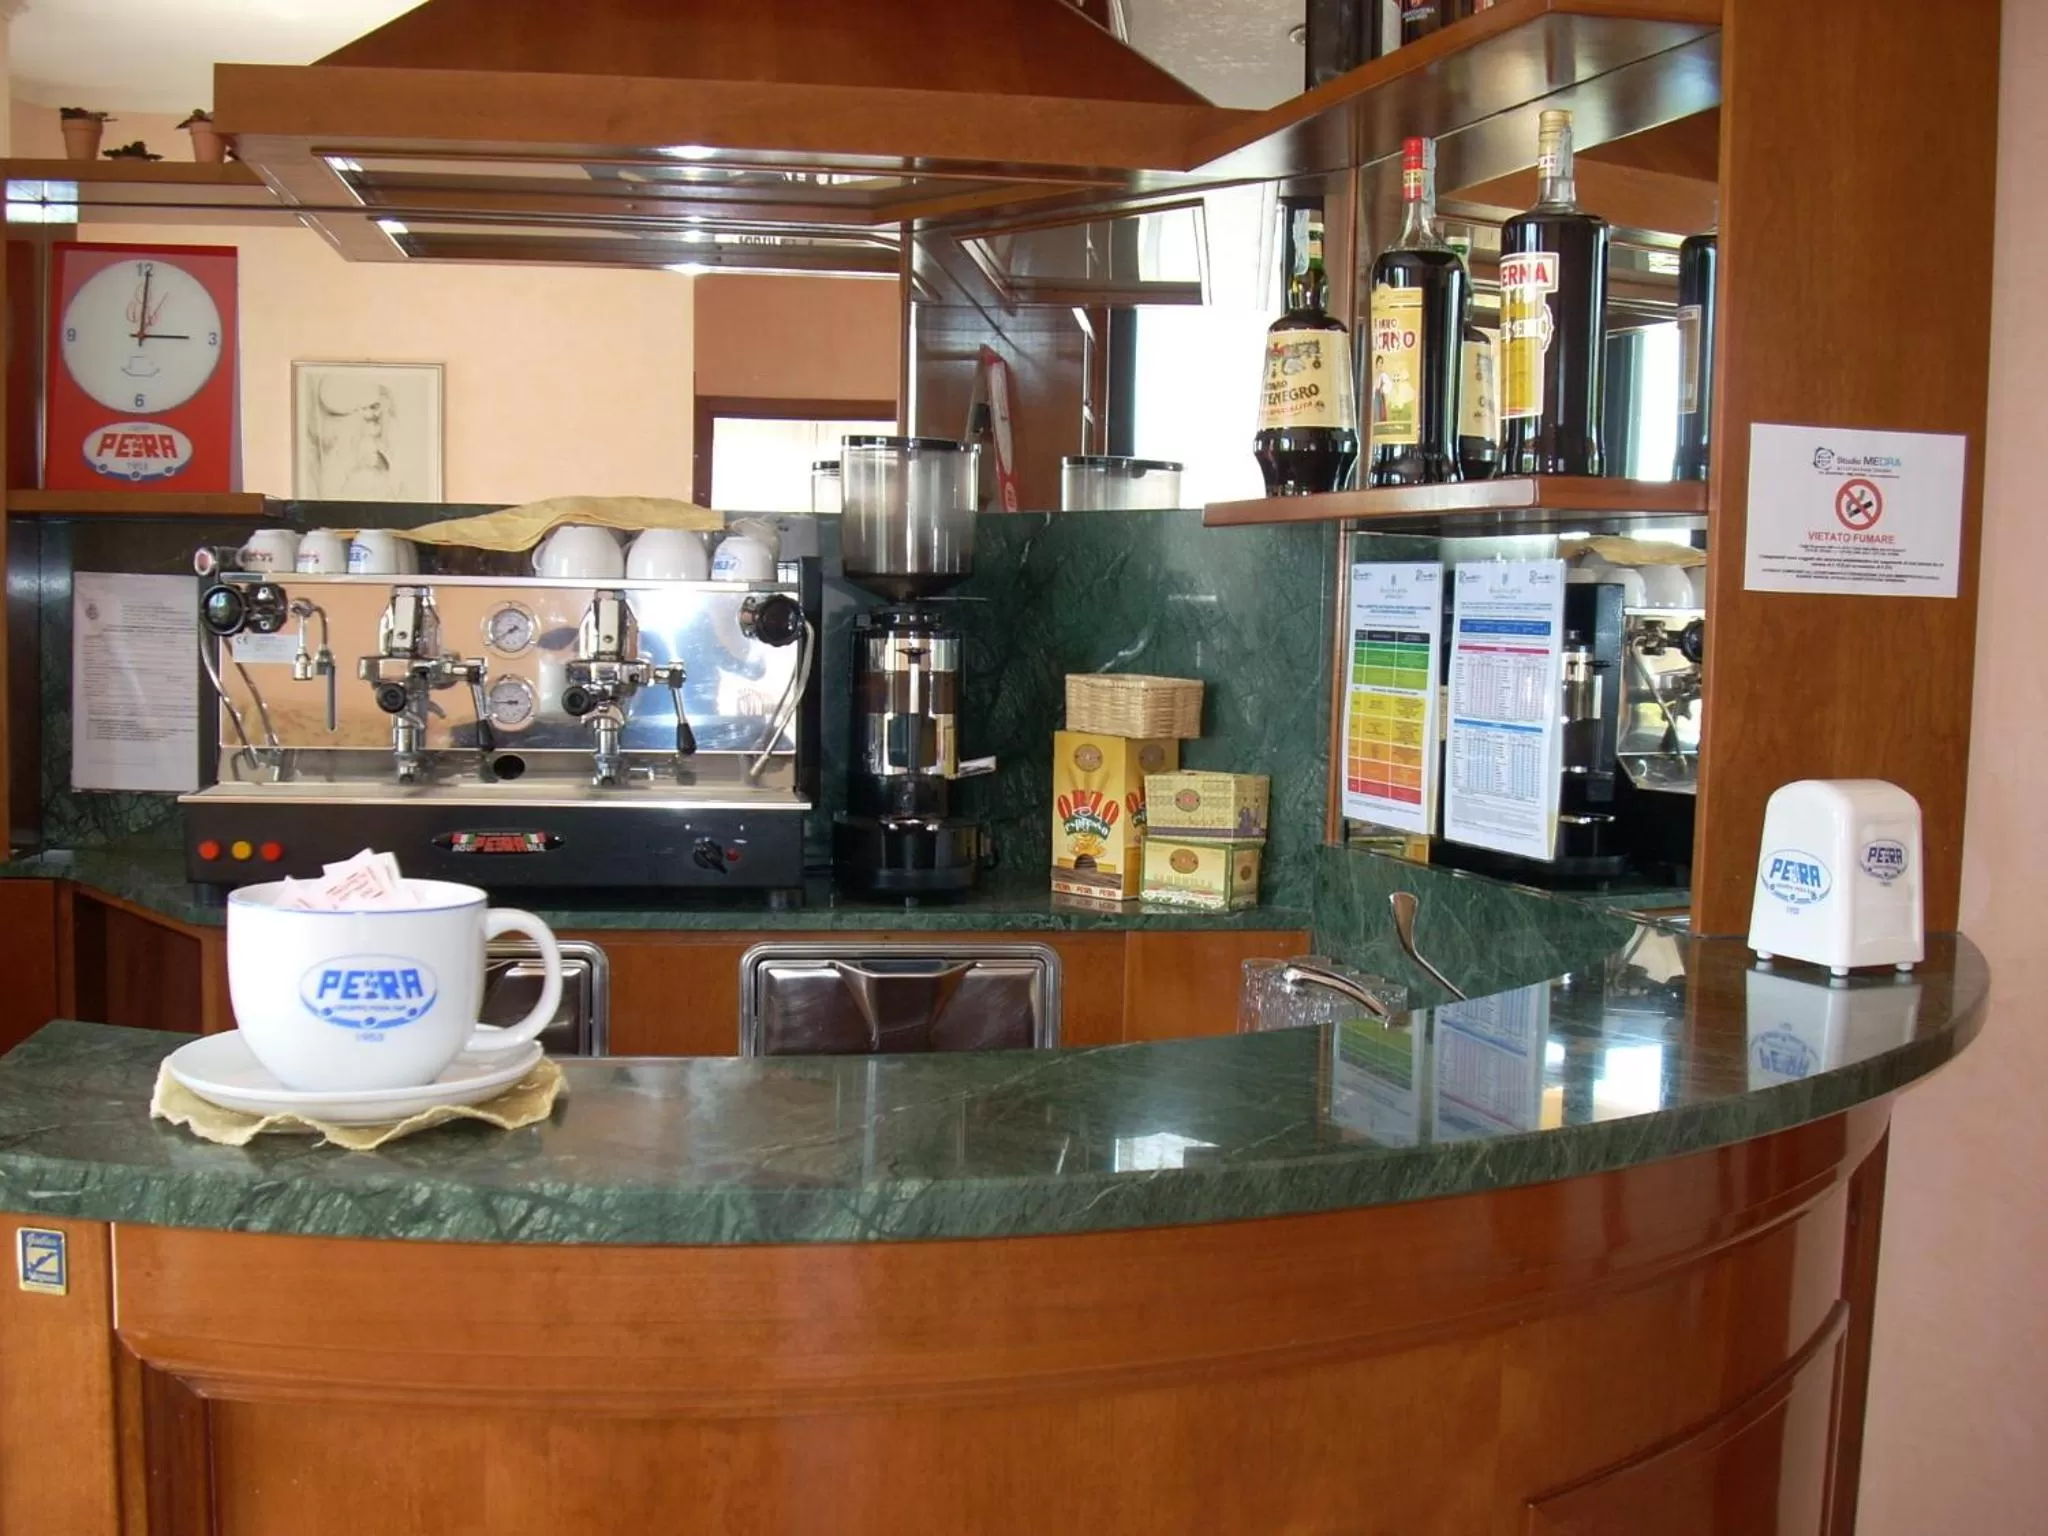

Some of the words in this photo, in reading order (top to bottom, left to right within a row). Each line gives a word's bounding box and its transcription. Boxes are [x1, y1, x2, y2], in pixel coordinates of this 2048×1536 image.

[136, 262, 154, 277] 12
[66, 328, 77, 342] 9
[208, 332, 218, 345] 3
[135, 394, 144, 408] 6
[1808, 531, 1850, 543] VIETATO
[1853, 533, 1895, 545] FUMARE
